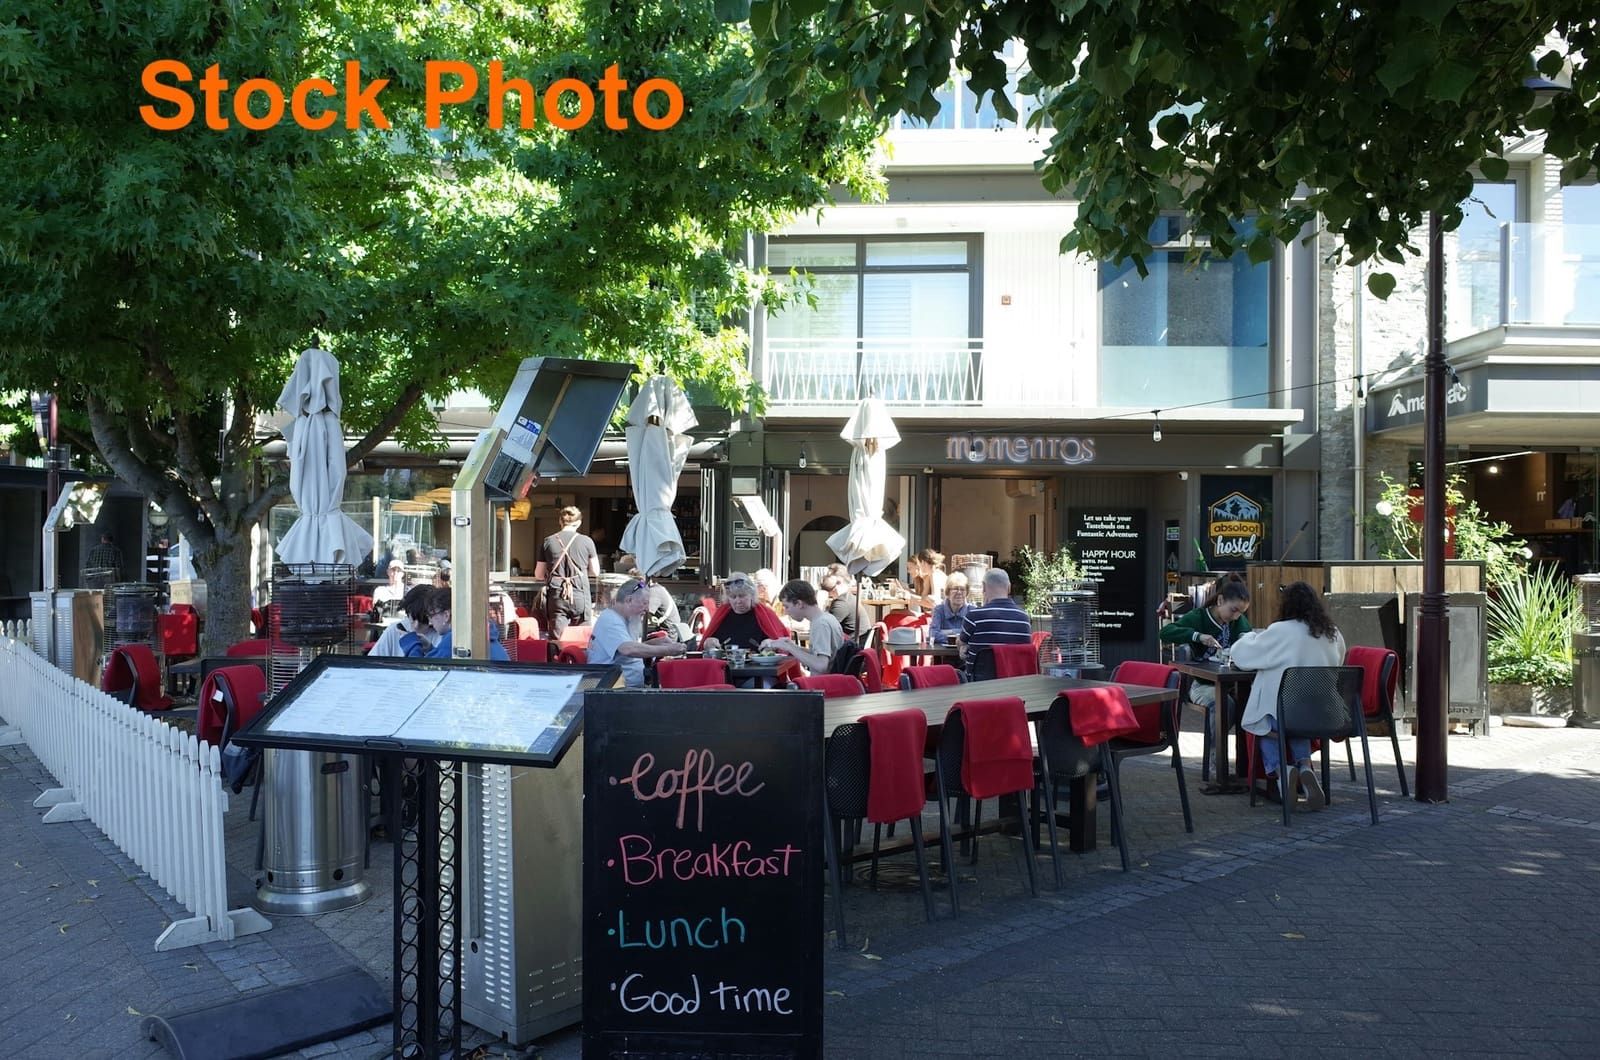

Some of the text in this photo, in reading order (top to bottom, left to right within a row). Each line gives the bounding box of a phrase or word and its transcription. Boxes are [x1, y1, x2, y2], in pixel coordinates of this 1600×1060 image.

[945, 435, 1096, 465] momentos
[1083, 514, 1094, 522] Let
[1103, 514, 1116, 522] take
[1116, 515, 1132, 524] your
[1085, 522, 1116, 530] Tastebuds
[1214, 523, 1258, 533] absoloot
[1105, 530, 1139, 539] Adventure
[1216, 534, 1256, 555] hostel
[1081, 550, 1136, 560] HAPPY HOUR
[620, 749, 765, 832] Coffee
[619, 834, 802, 885] Breakfast
[618, 907, 746, 948] Lunch
[619, 973, 793, 1015] Good time
